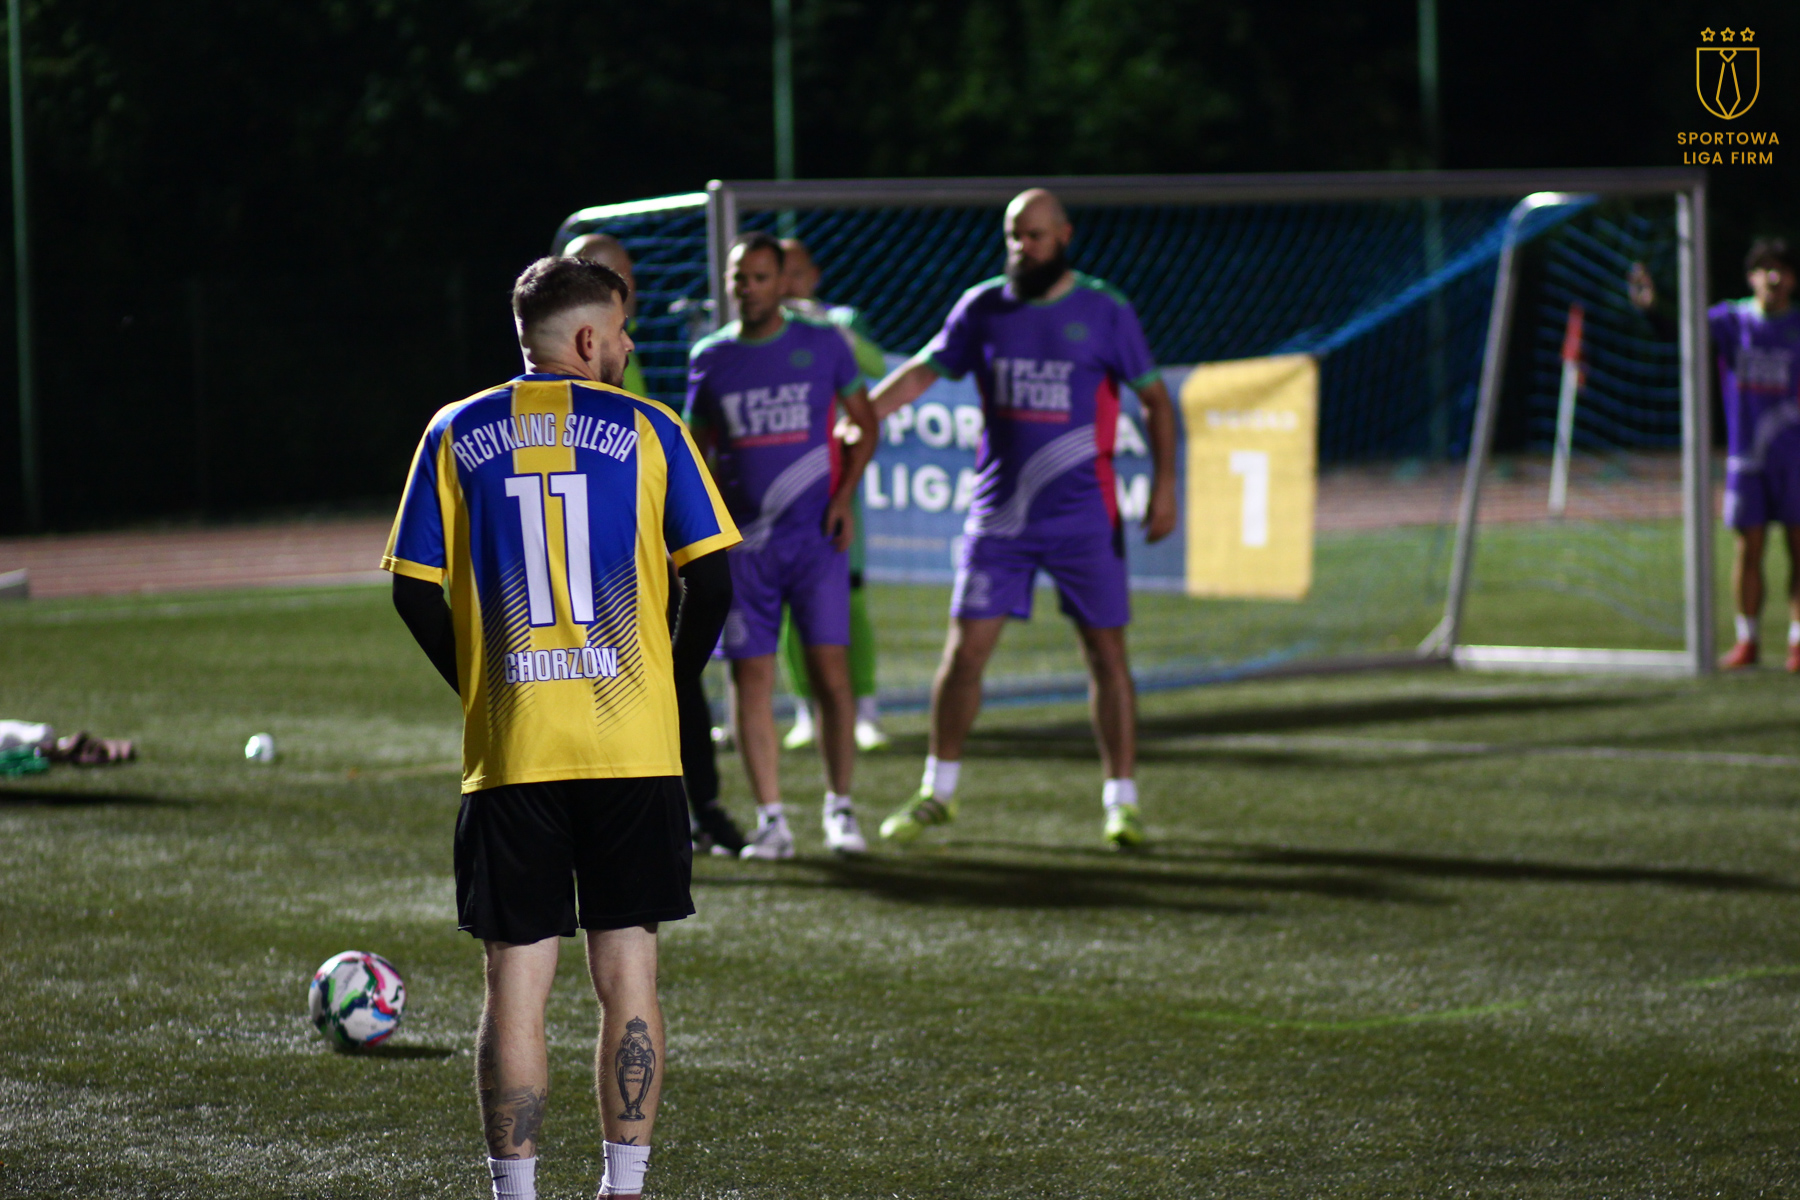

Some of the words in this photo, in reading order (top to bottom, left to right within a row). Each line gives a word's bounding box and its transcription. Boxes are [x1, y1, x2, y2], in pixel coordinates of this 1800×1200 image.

[1012, 358, 1075, 381] PLAY
[746, 382, 811, 409] PLAY
[1012, 381, 1072, 411] FOR
[747, 403, 811, 435] FOR
[451, 413, 556, 473] RECYKLING
[562, 413, 640, 463] SILESIA
[1229, 450, 1270, 549] 1
[504, 472, 596, 626] 11
[503, 639, 618, 685] CHORZÓW
